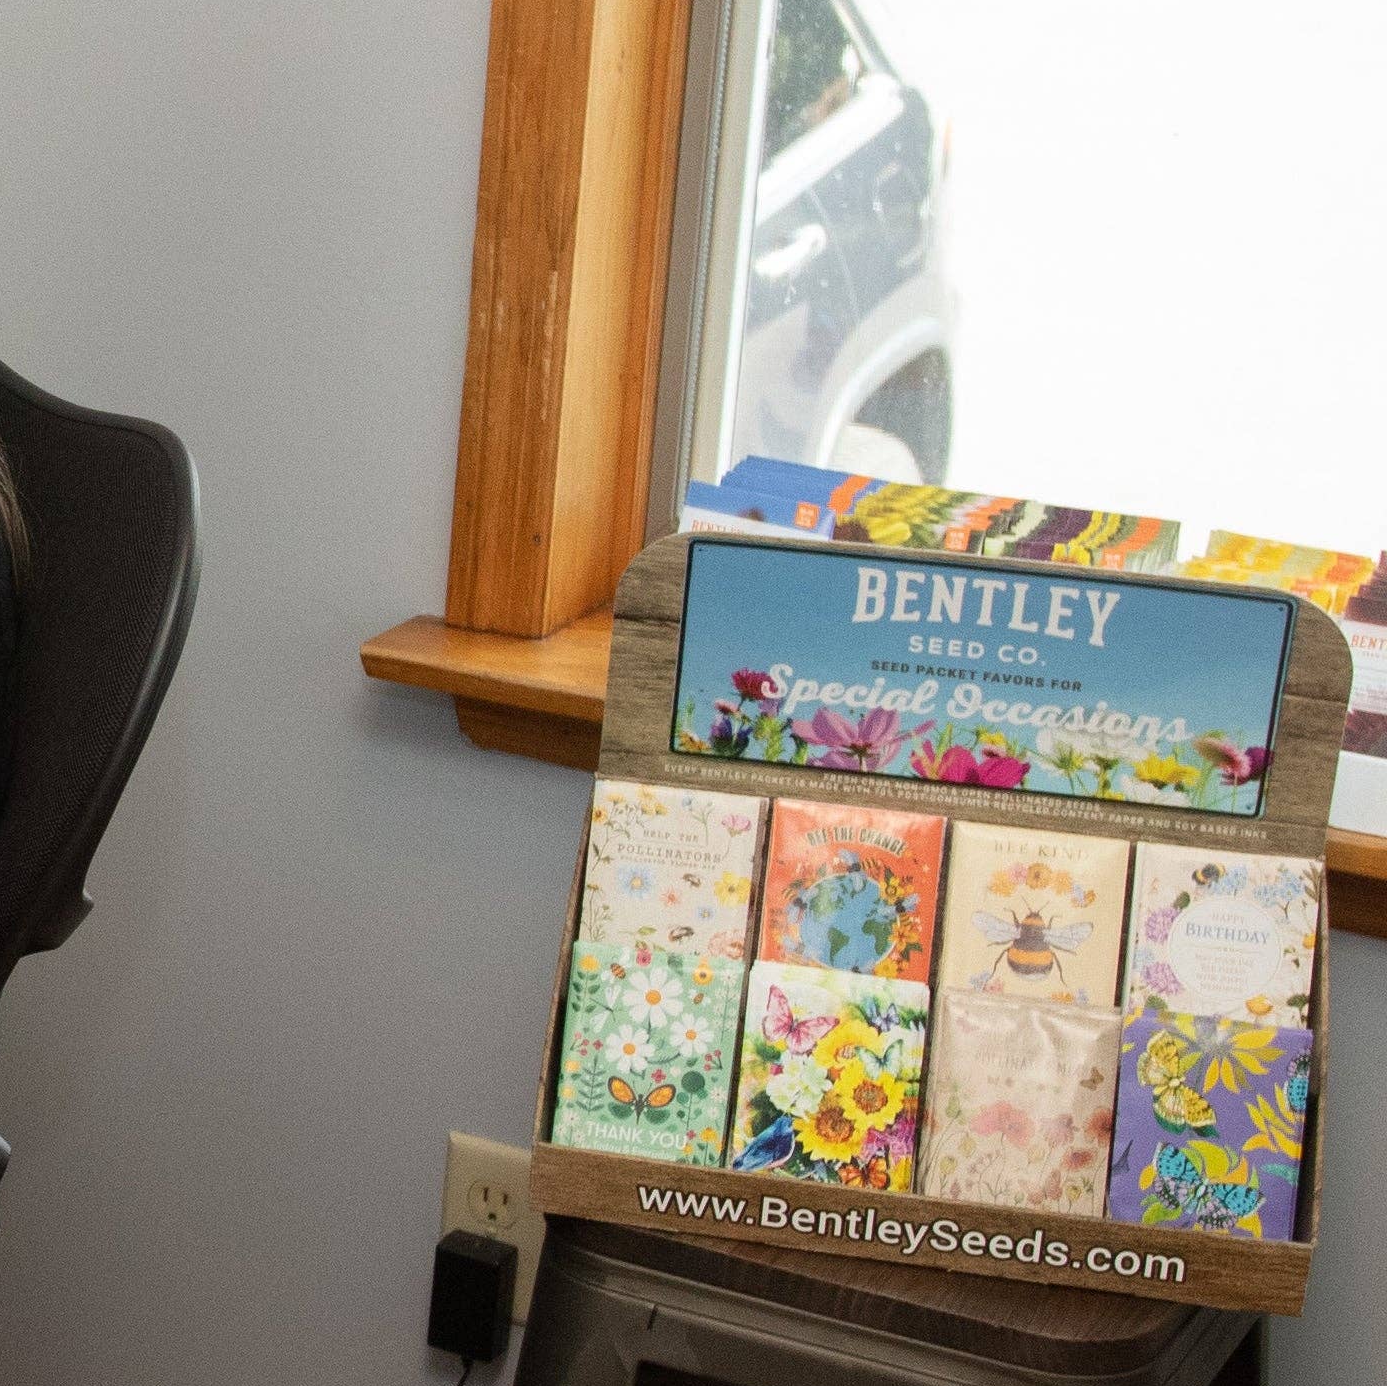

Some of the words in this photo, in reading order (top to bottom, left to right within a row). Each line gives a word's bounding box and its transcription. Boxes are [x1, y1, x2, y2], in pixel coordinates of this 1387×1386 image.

[851, 566, 1121, 647] BENTLEY
[908, 635, 985, 659] SEED
[997, 645, 1046, 666] CO.
[871, 661, 909, 674] SEED
[916, 665, 976, 681] PACKET
[983, 672, 1045, 689] FAVORS
[1051, 678, 1082, 692] FOR
[760, 663, 939, 715] Special
[946, 683, 1194, 744] Occasions
[700, 768, 746, 780] BENTLEY
[750, 774, 790, 786] PACKET
[617, 844, 722, 863] POLLINATORS
[806, 830, 828, 846] BEE
[833, 826, 854, 842] THE
[858, 828, 907, 856] CHANGE
[1038, 844, 1089, 860] KIND
[1212, 912, 1245, 925] HAPPY
[1185, 922, 1269, 945] BIRTHDAY
[585, 1121, 642, 1143] THANK
[649, 1131, 687, 1150] YOU
[636, 1183, 1186, 1283] www.BentleySeeds.com
